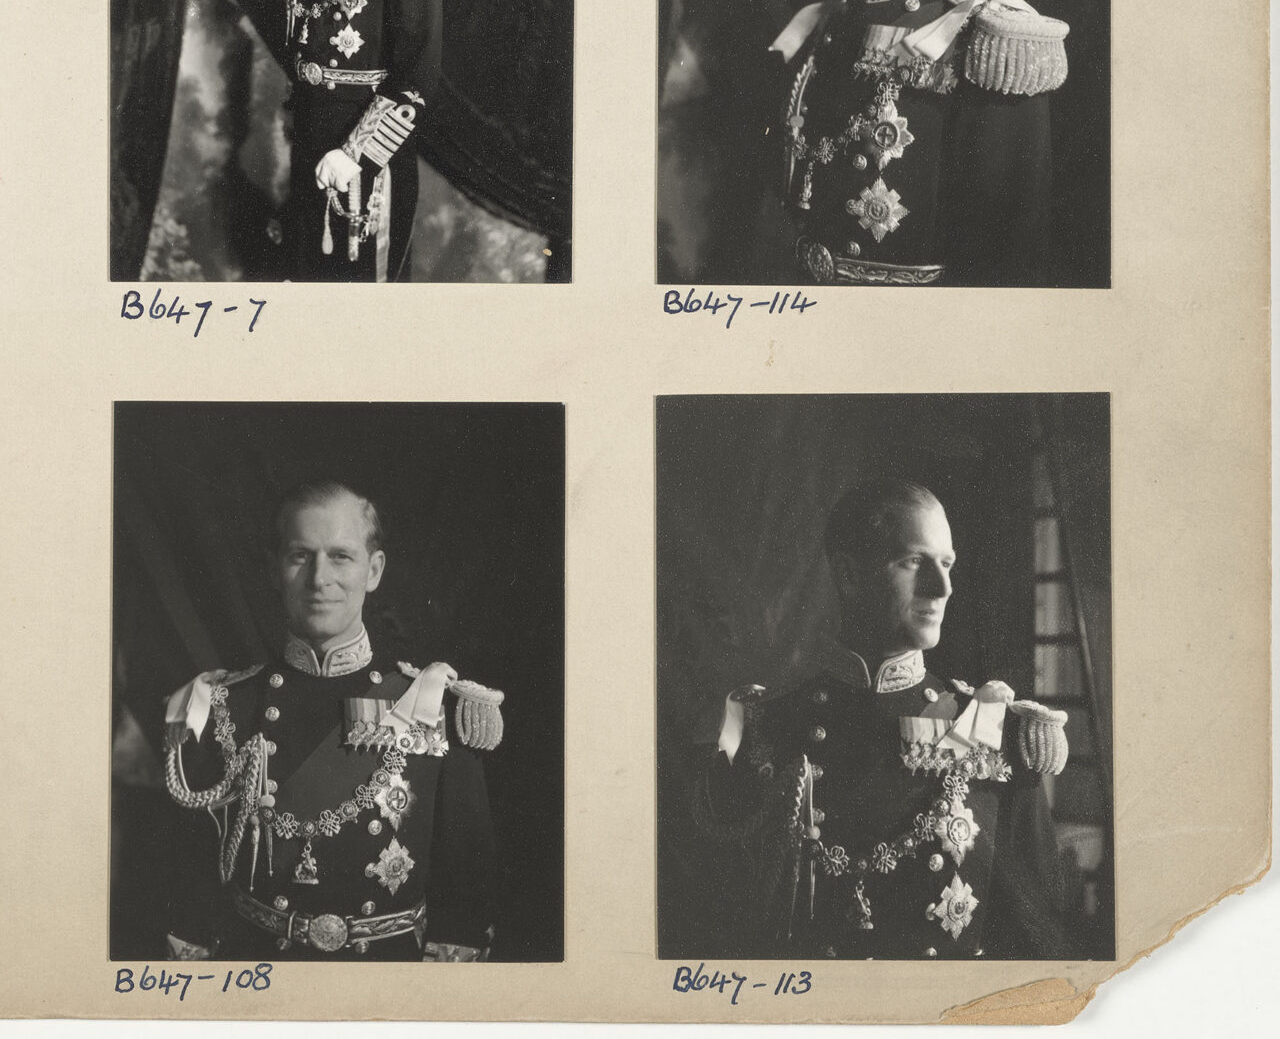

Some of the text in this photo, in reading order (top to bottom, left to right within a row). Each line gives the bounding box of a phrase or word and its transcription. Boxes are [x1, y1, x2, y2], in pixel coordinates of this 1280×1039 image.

[120, 288, 268, 338] B647-7
[664, 288, 818, 330] B647-114
[115, 963, 273, 1002] B647-108
[673, 963, 813, 1006] B647-113
